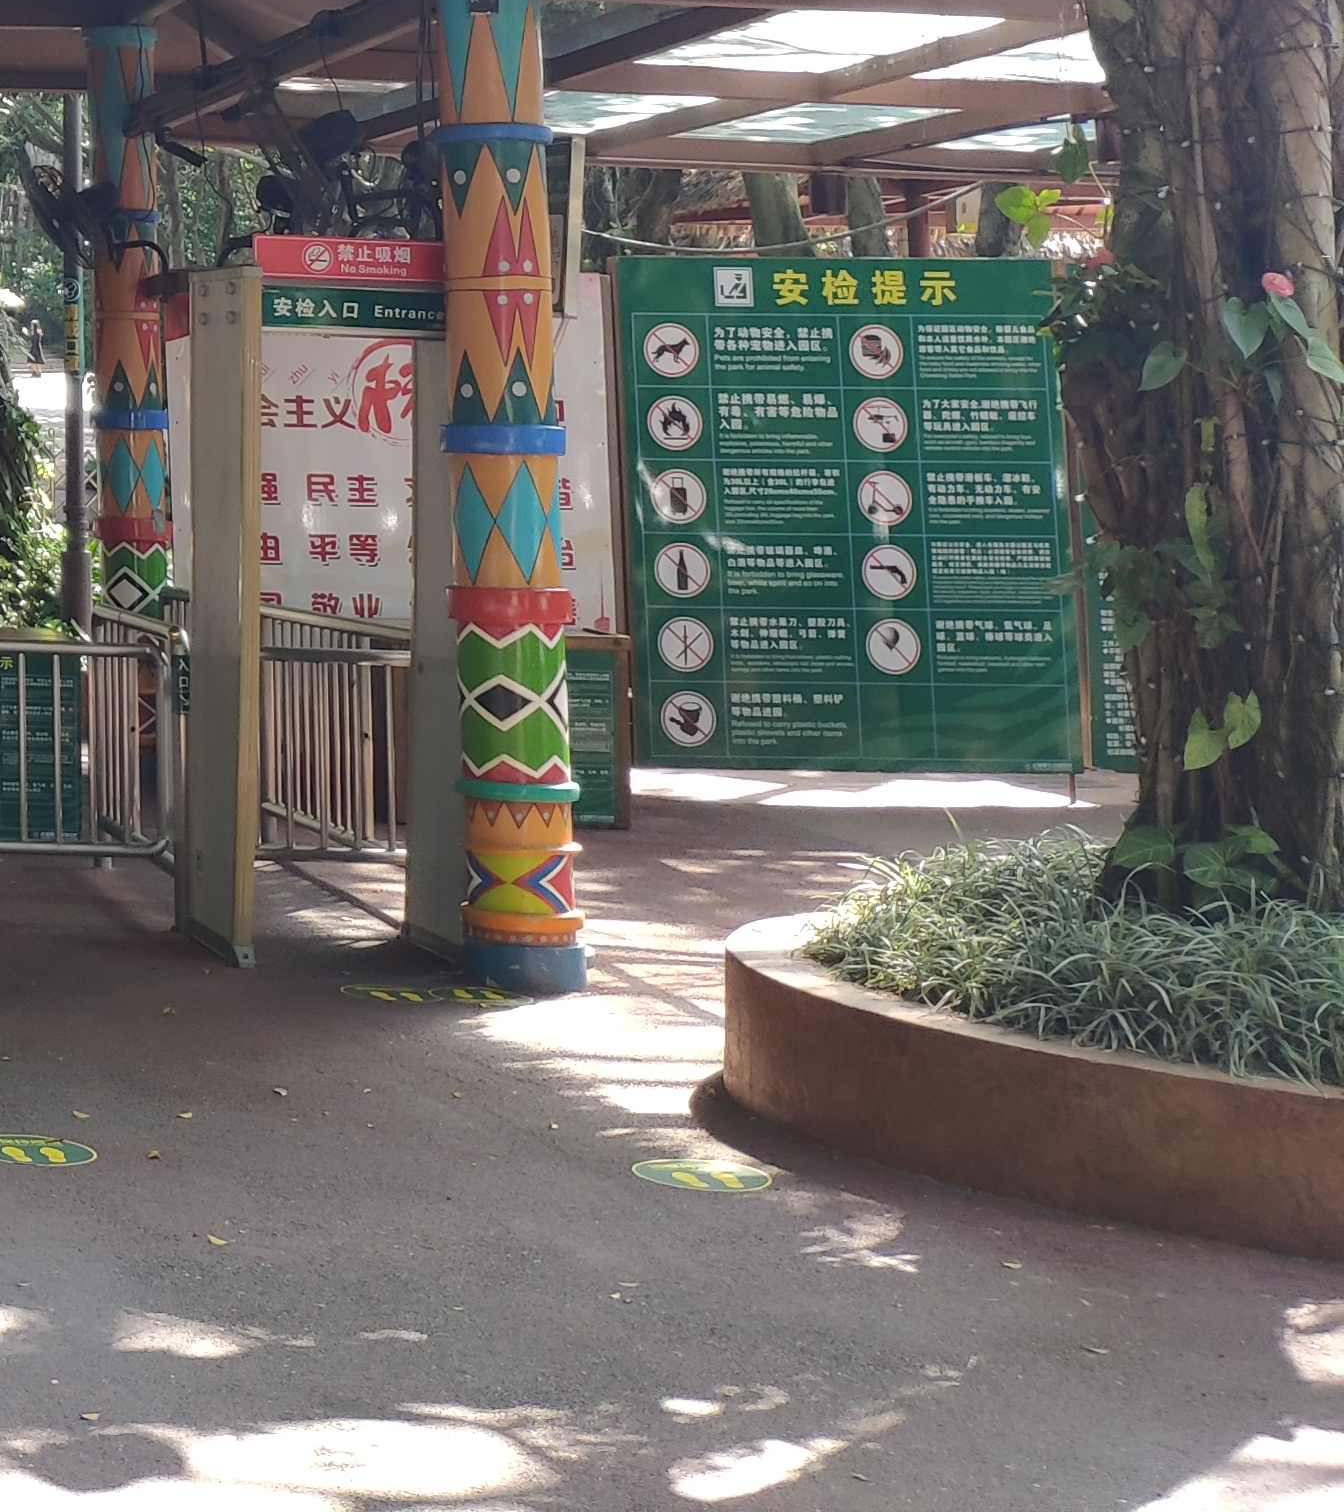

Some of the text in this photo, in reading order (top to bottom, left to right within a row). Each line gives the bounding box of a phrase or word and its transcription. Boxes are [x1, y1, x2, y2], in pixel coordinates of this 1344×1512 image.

[337, 244, 411, 265] 禁止吸烟
[341, 263, 407, 277] No Smoking
[772, 269, 957, 306] 安检提示
[272, 297, 444, 321] 安检入口 Entrance
[288, 363, 309, 386] zhu
[327, 370, 340, 384] yi
[306, 473, 377, 503] 民主
[309, 534, 378, 563] 平等
[178, 658, 189, 688] 入口
